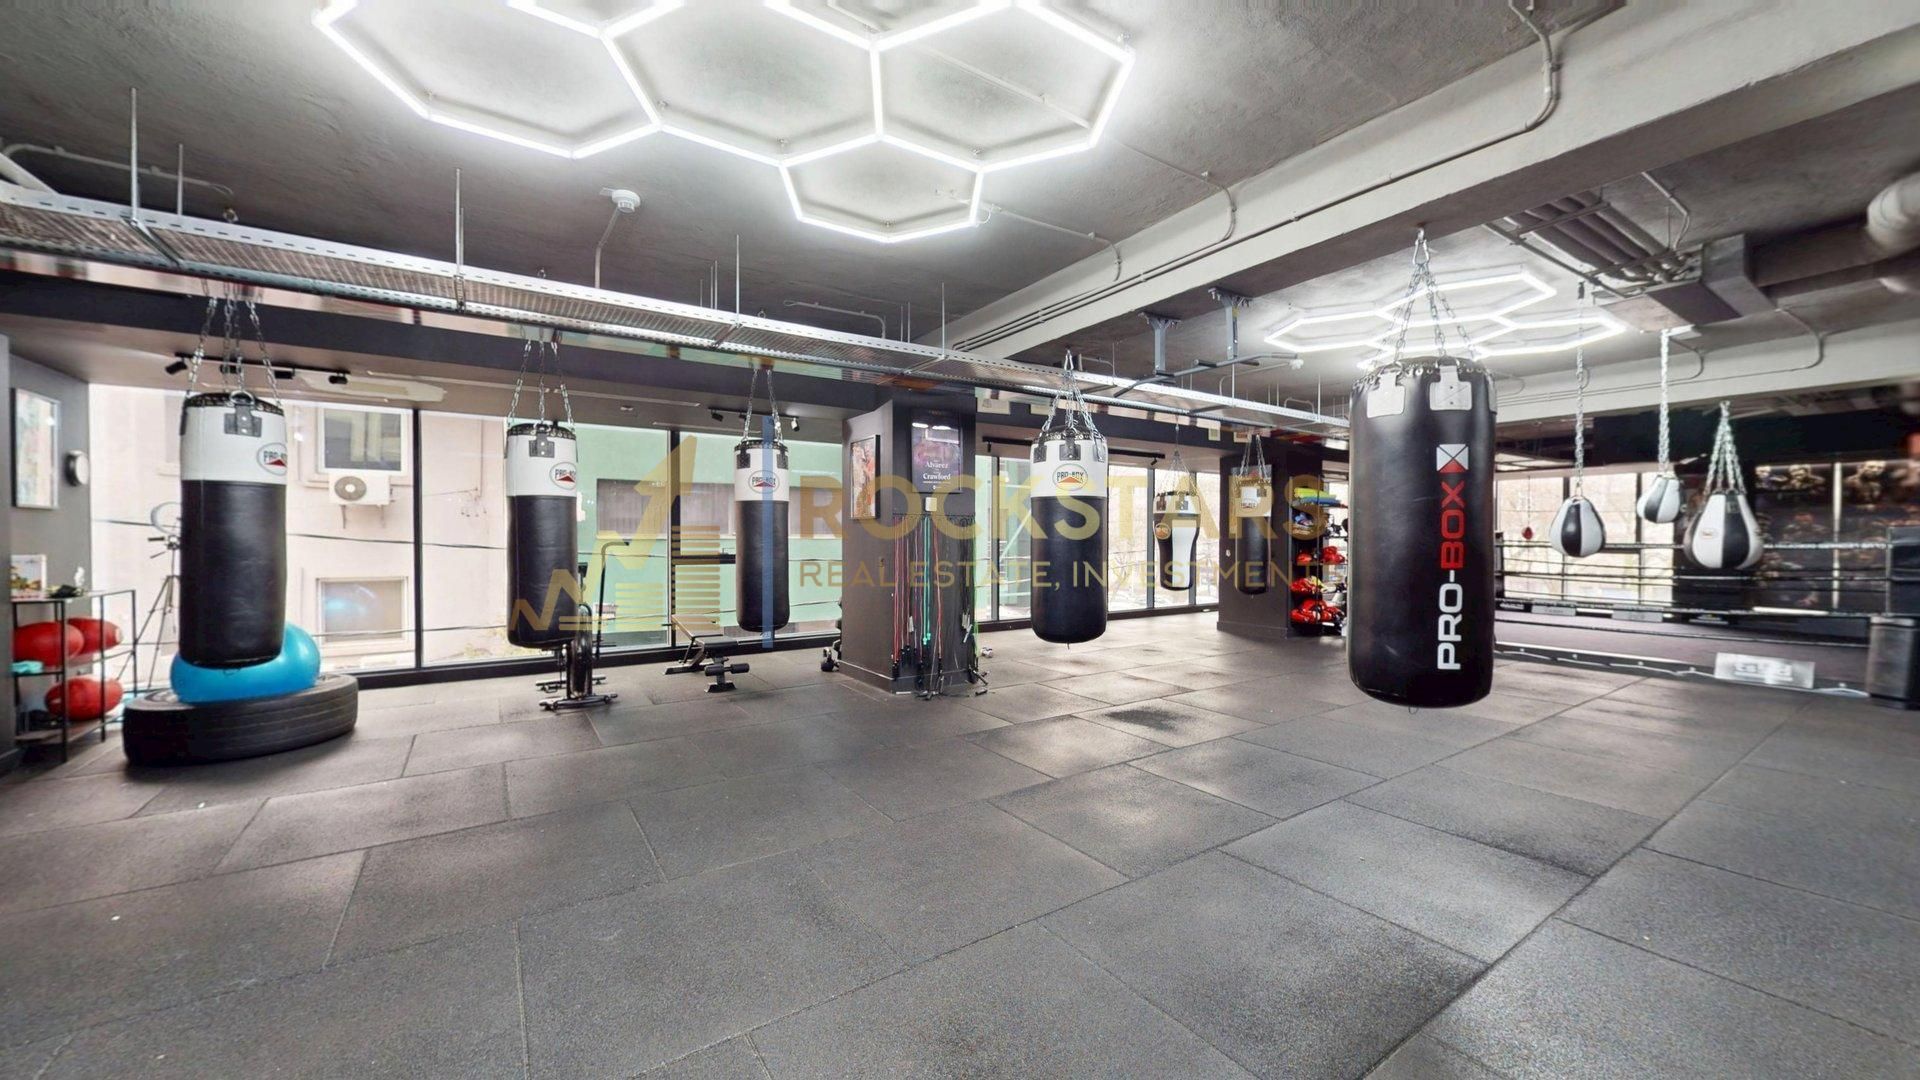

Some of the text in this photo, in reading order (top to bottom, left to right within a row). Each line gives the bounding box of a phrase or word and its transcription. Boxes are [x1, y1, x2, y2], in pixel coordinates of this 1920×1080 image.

[926, 461, 949, 469] Alvarez
[922, 473, 952, 481] Crawford
[1056, 471, 1085, 483] PRO-BOX
[1436, 481, 1465, 670] PRO-BOX
